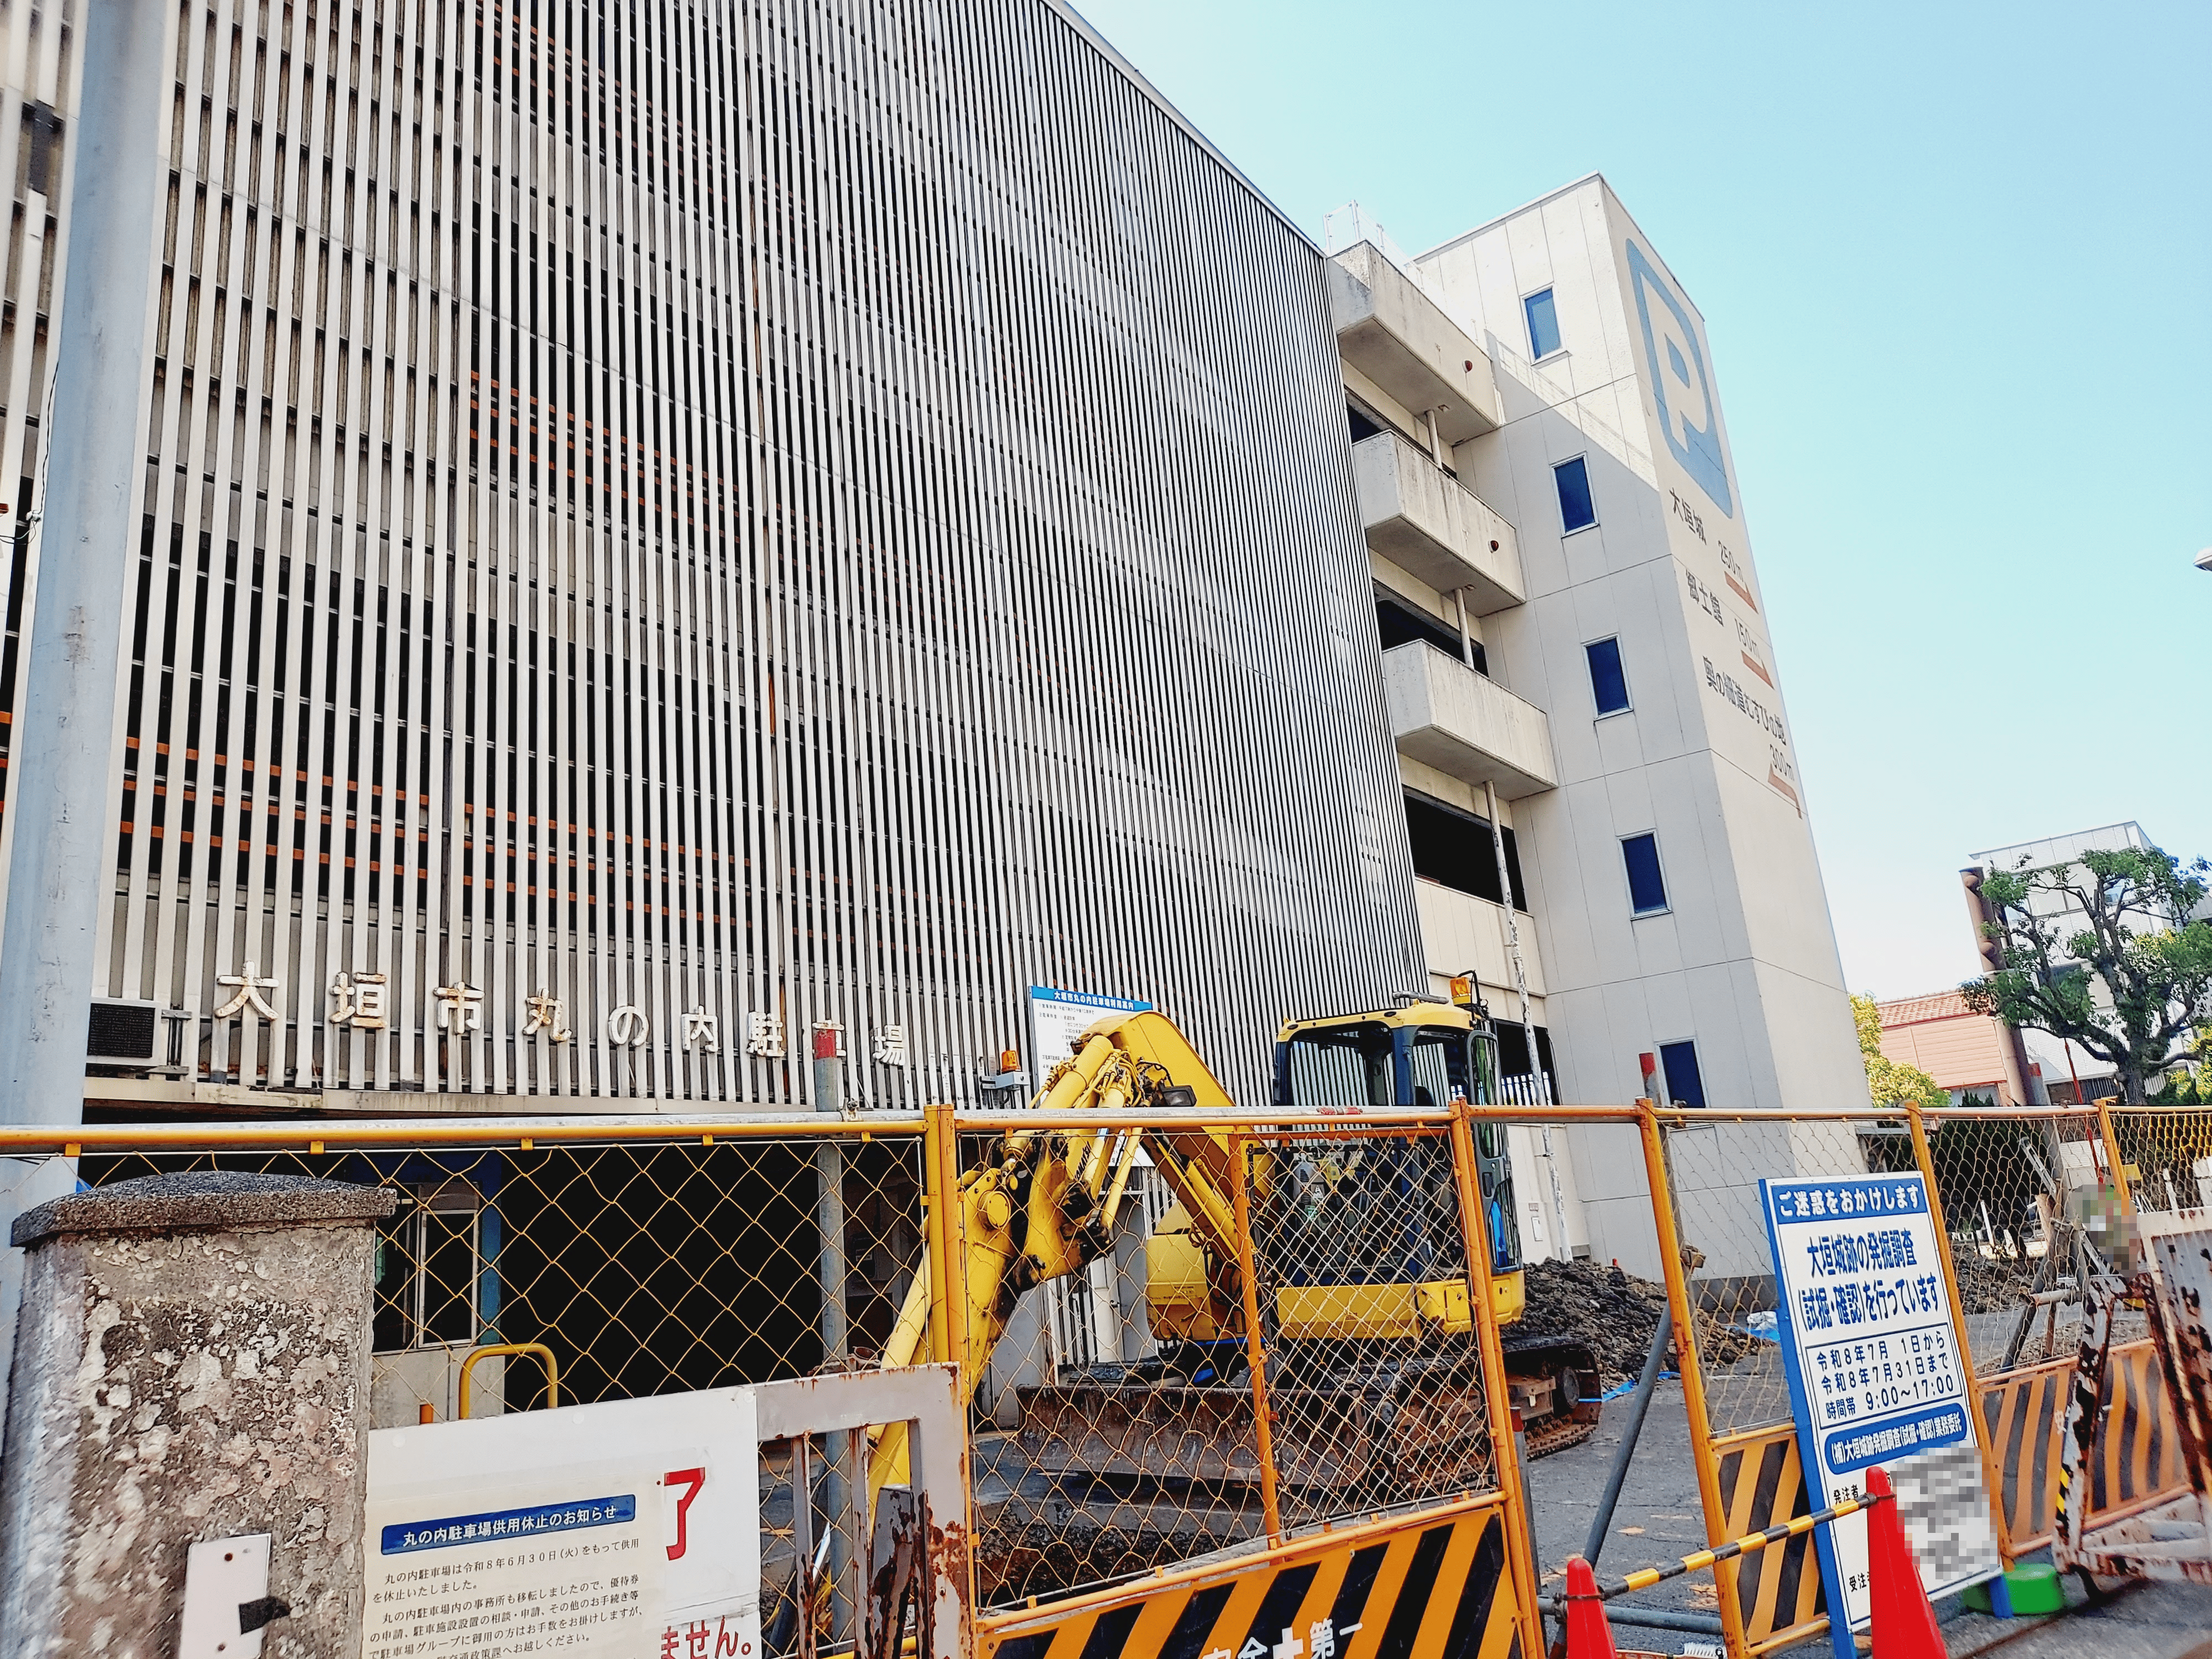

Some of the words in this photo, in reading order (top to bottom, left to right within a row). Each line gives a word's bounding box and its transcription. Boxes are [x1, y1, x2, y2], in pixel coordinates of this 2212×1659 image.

[1640, 271, 1707, 453] P
[1669, 487, 1707, 546] 大垣城
[1718, 540, 1744, 582] 250m
[1734, 618, 1760, 660] 150m
[1703, 655, 1787, 746] 奥の細道むすびの地
[1770, 744, 1794, 781] 300m
[1053, 990, 1134, 1011] 大垣市丸の内駐車場利用案内
[1779, 1184, 1919, 1217] ご迷惑をおかけします
[1807, 1227, 1917, 1278] 大垣城跡の発掘調査
[1798, 1272, 1939, 1332] (試掘・確認)を行っています
[1817, 1340, 1888, 1371] 令和8年7月
[1901, 1331, 1945, 1354] 1日から
[1821, 1352, 1948, 1396] 令和8年7月31日まで
[1825, 1396, 1856, 1420] 時間帯
[1834, 1484, 1859, 1505] 発注者
[403, 1505, 617, 1547] 丸の内駐車場供用休止のお知らせ
[373, 1579, 477, 1603] を休止いたしました。
[382, 1574, 639, 1624] 丸の内駐車場内の事務所も移転しましたので、優待券
[1849, 1571, 1869, 1593] 受注
